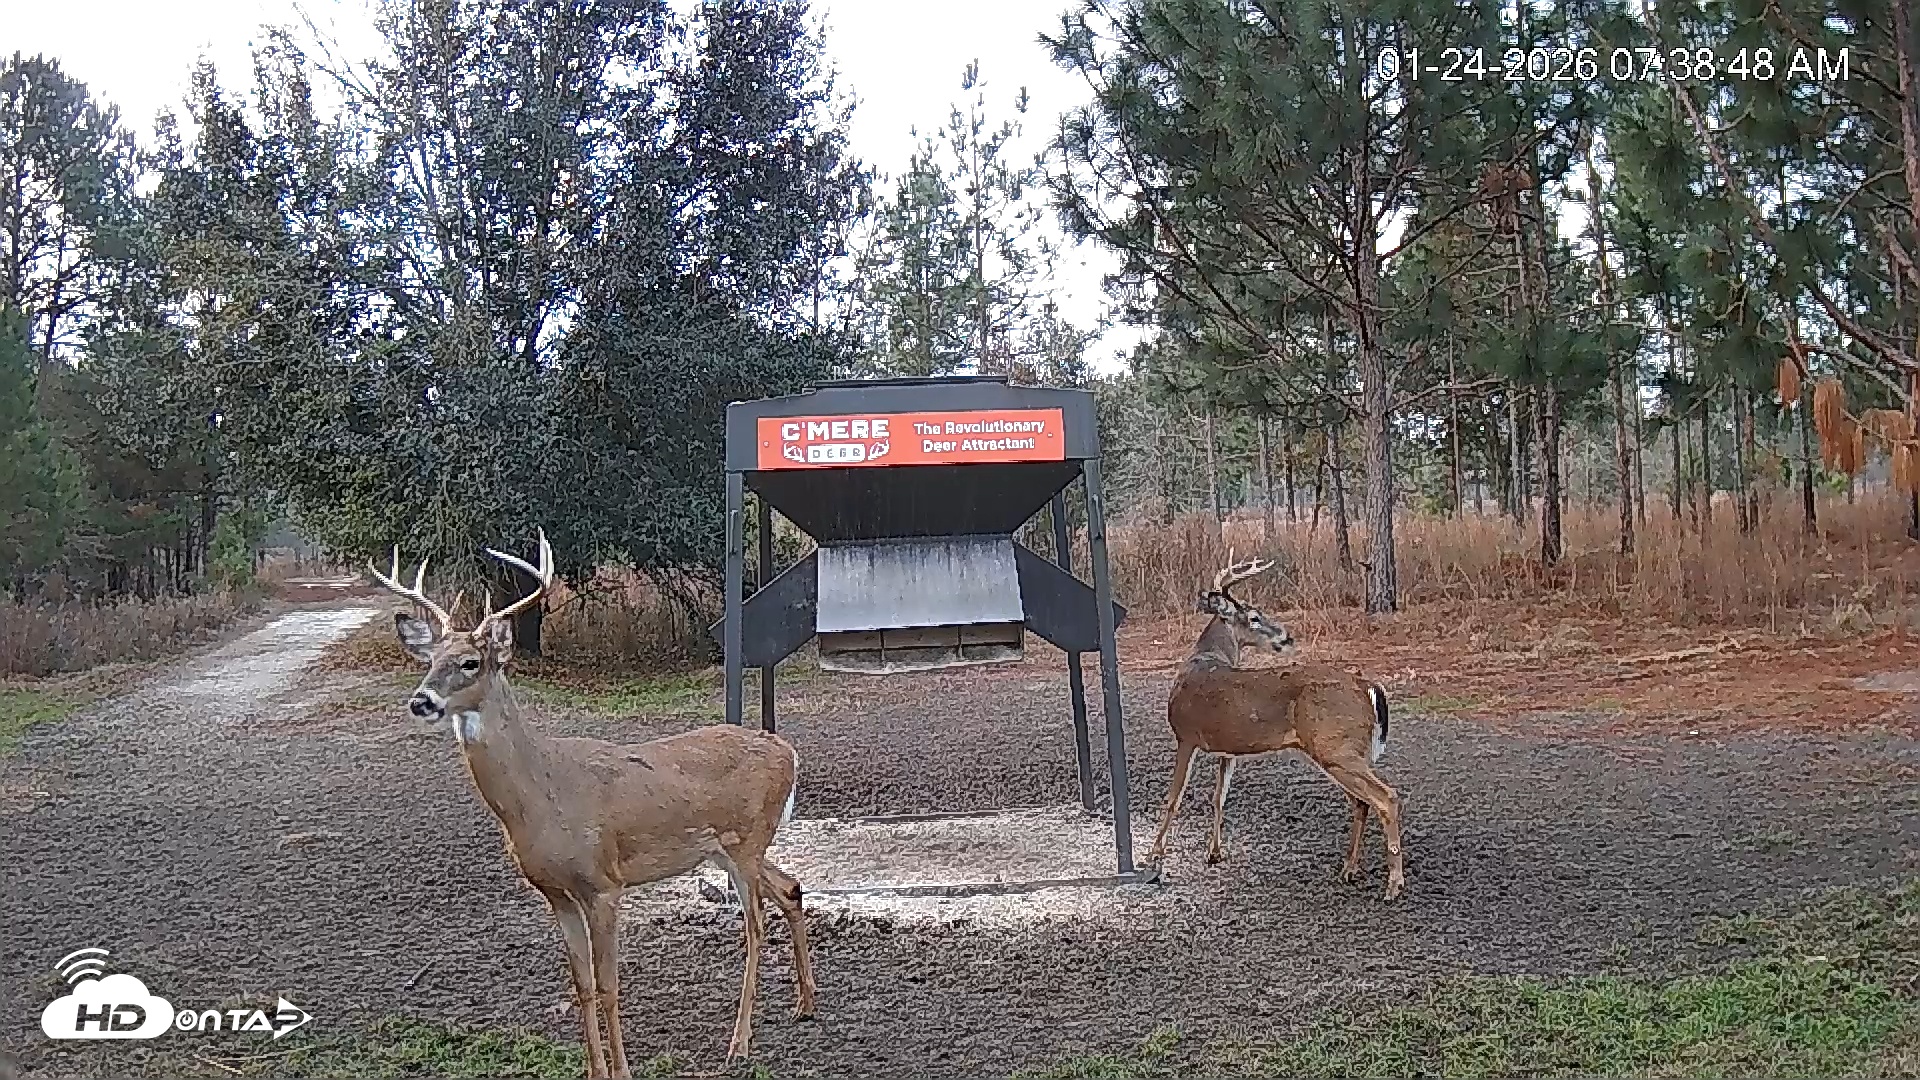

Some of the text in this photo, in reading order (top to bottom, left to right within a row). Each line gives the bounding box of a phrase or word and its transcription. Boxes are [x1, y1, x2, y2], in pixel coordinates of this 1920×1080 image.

[781, 419, 890, 441] C'MERE
[914, 420, 1046, 435] The Revolutionary
[922, 437, 1036, 452] Deer Attractant
[812, 446, 862, 459] DEER
